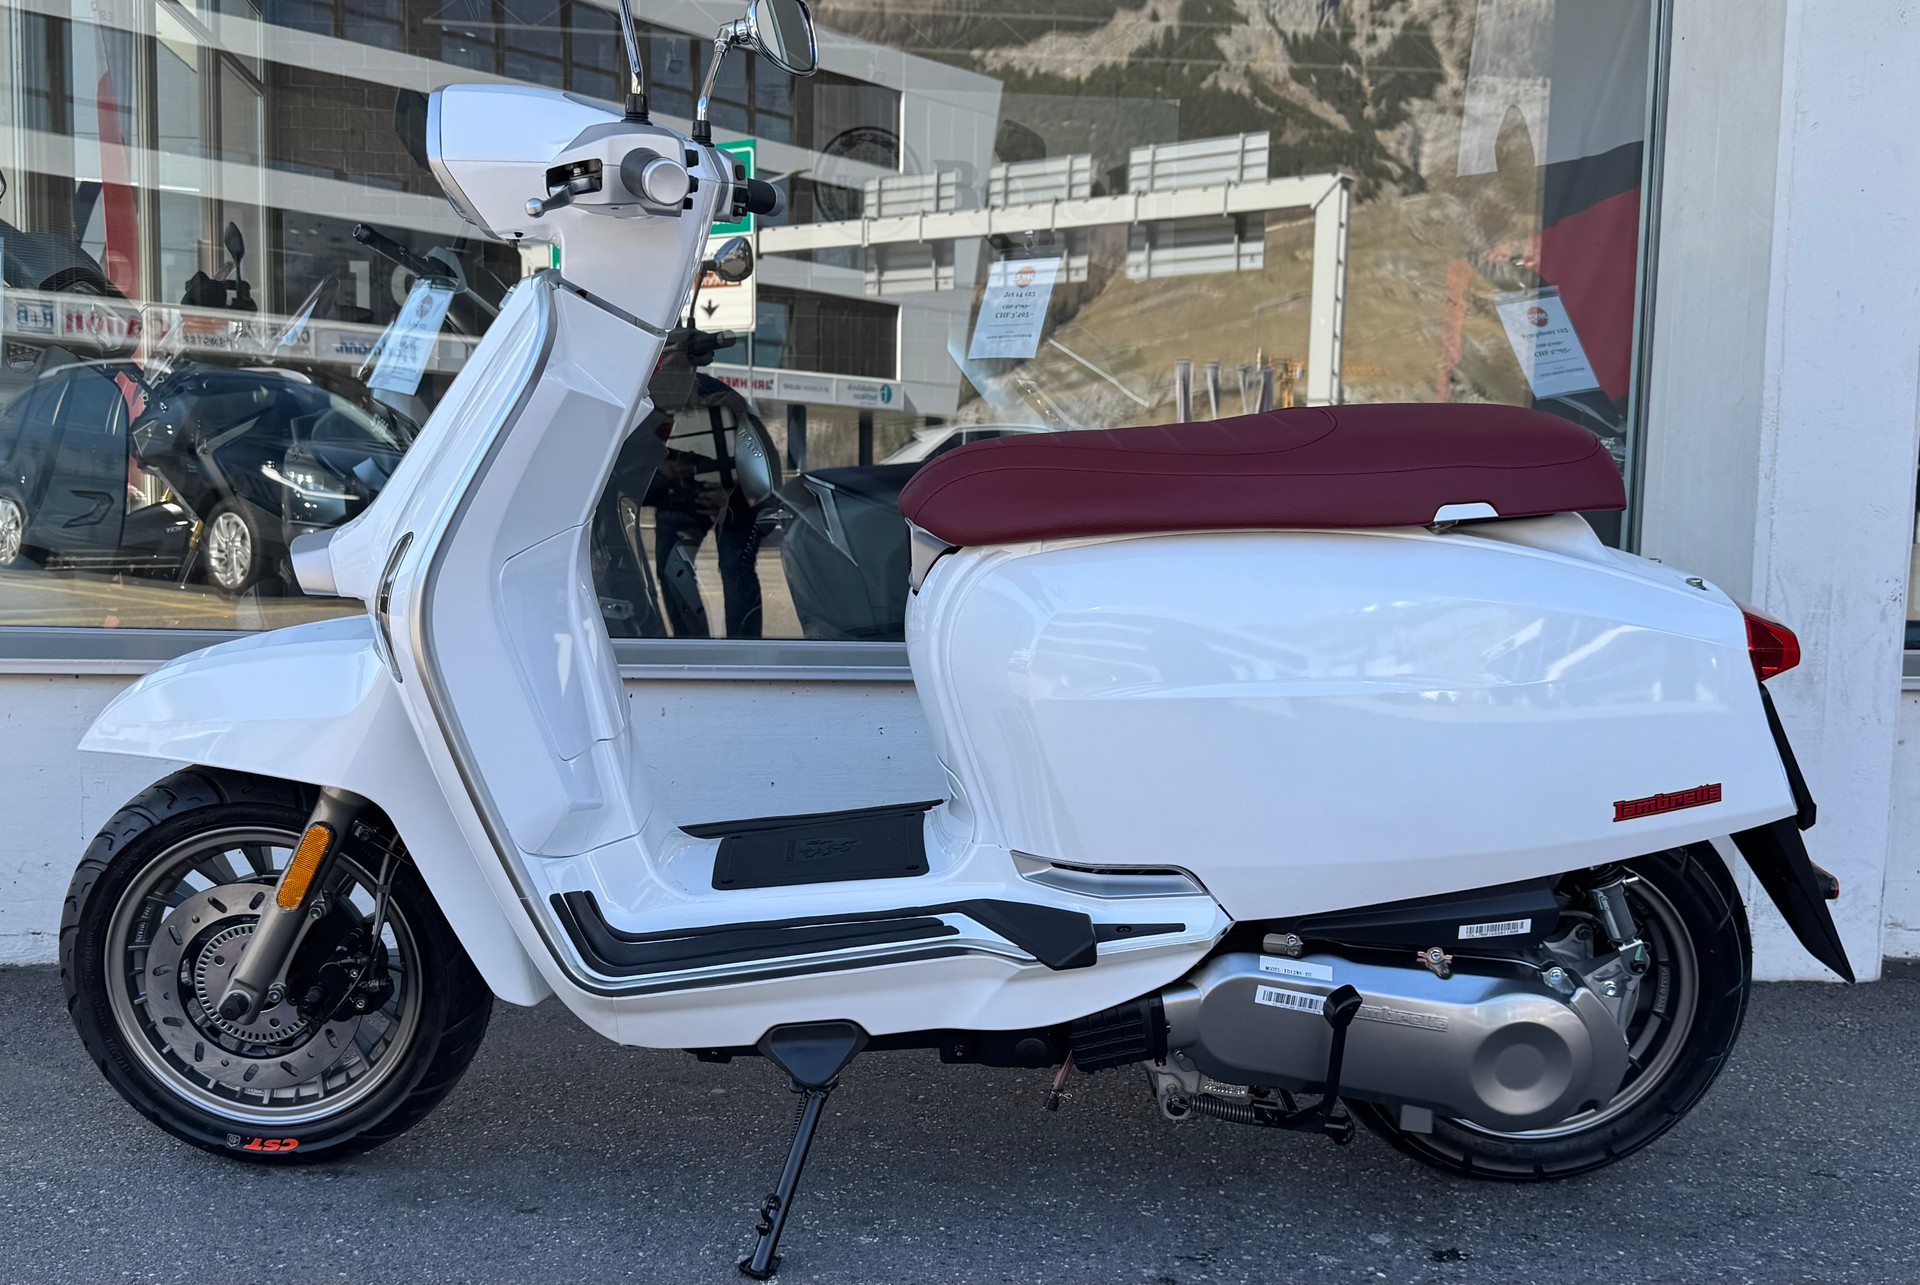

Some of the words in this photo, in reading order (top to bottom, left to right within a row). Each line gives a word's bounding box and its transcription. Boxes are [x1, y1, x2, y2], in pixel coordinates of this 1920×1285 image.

[1521, 329, 1556, 340] Symphony
[1613, 783, 1722, 822] Lambretta
[1354, 1005, 1449, 1032] ambretta
[244, 1138, 300, 1152] CST
